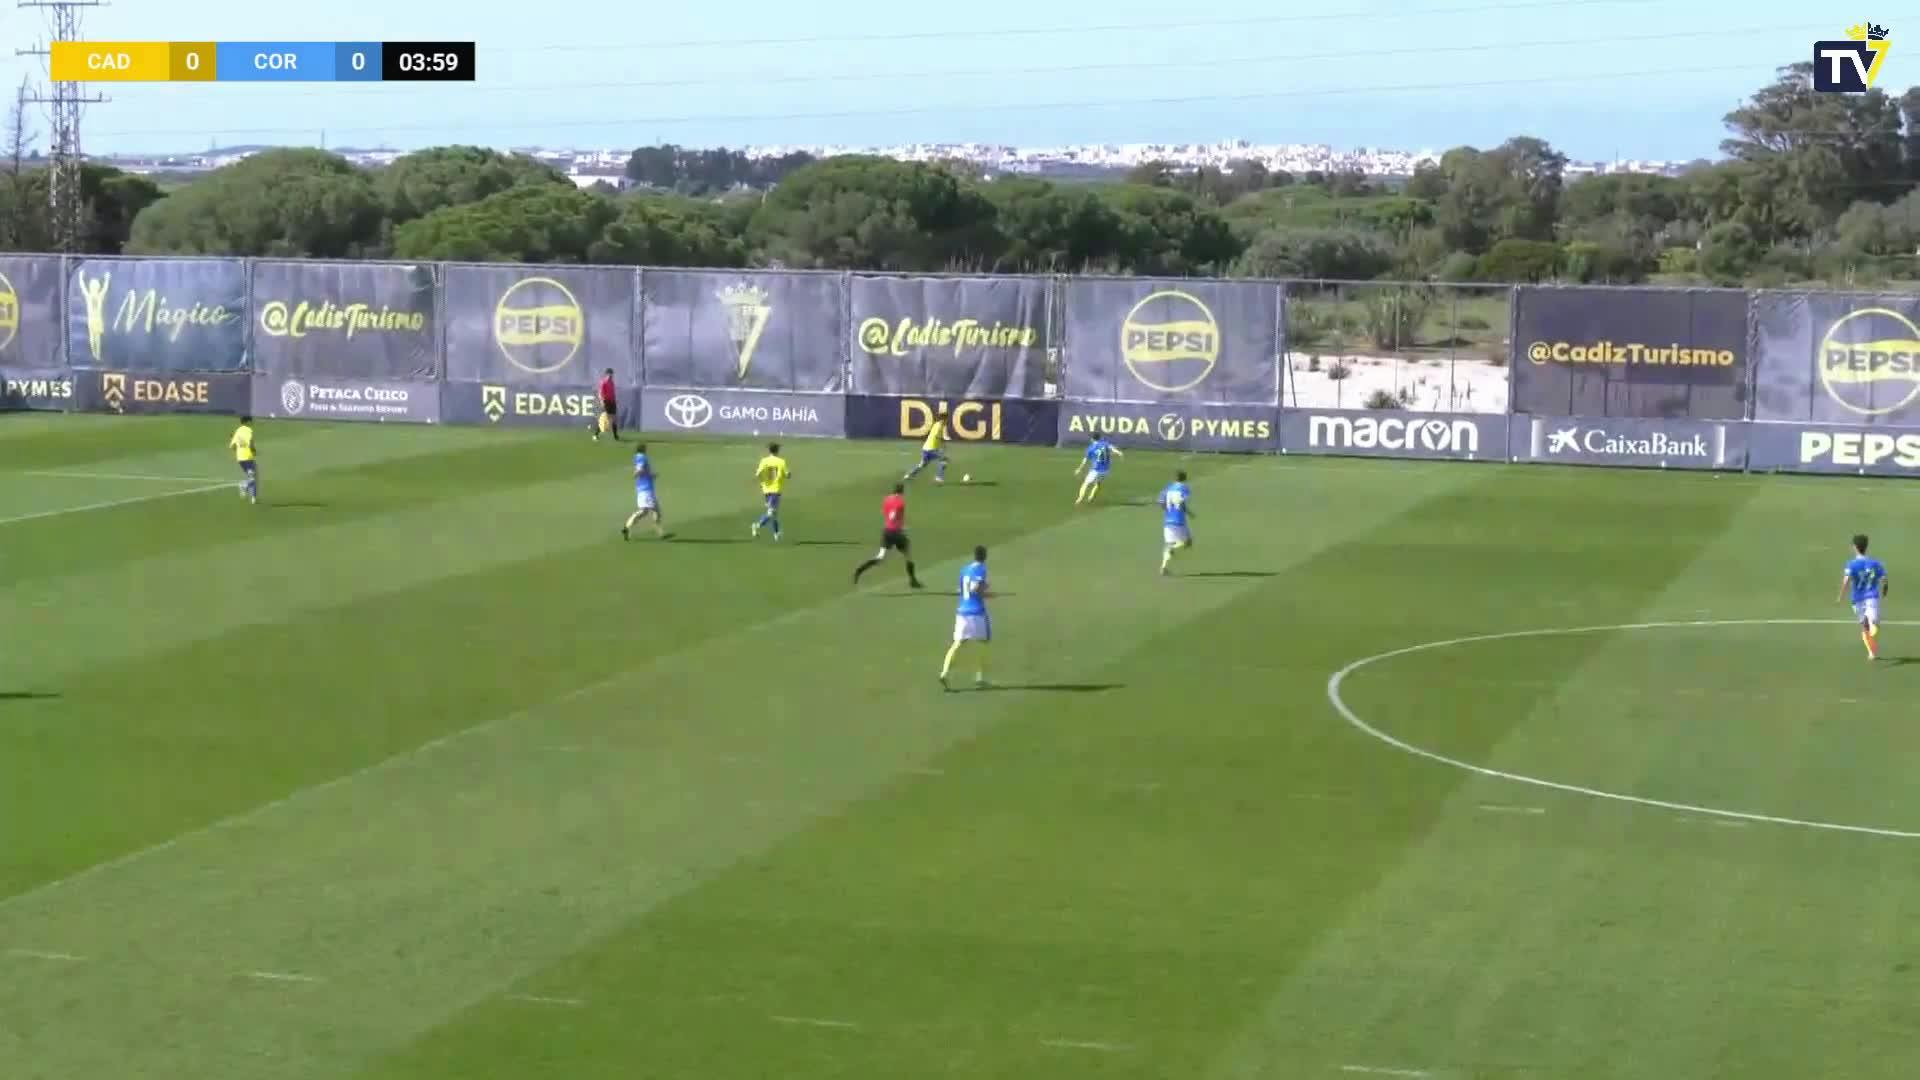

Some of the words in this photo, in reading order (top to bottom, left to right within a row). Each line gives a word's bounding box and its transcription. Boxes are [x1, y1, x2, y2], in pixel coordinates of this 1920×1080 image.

[500, 314, 576, 334] PEPSI
[1127, 330, 1213, 353] PEPSI
[1528, 341, 1735, 366] @CadizTurismo
[6, 379, 73, 398] PYMES
[134, 381, 209, 403] EDASE
[515, 393, 596, 416] EDASE
[719, 405, 768, 420] GAMO
[1069, 416, 1150, 434] AYUDA
[1191, 420, 1270, 438] PYMES
[1309, 415, 1479, 451] macron
[1584, 429, 1707, 457] CaixaBank
